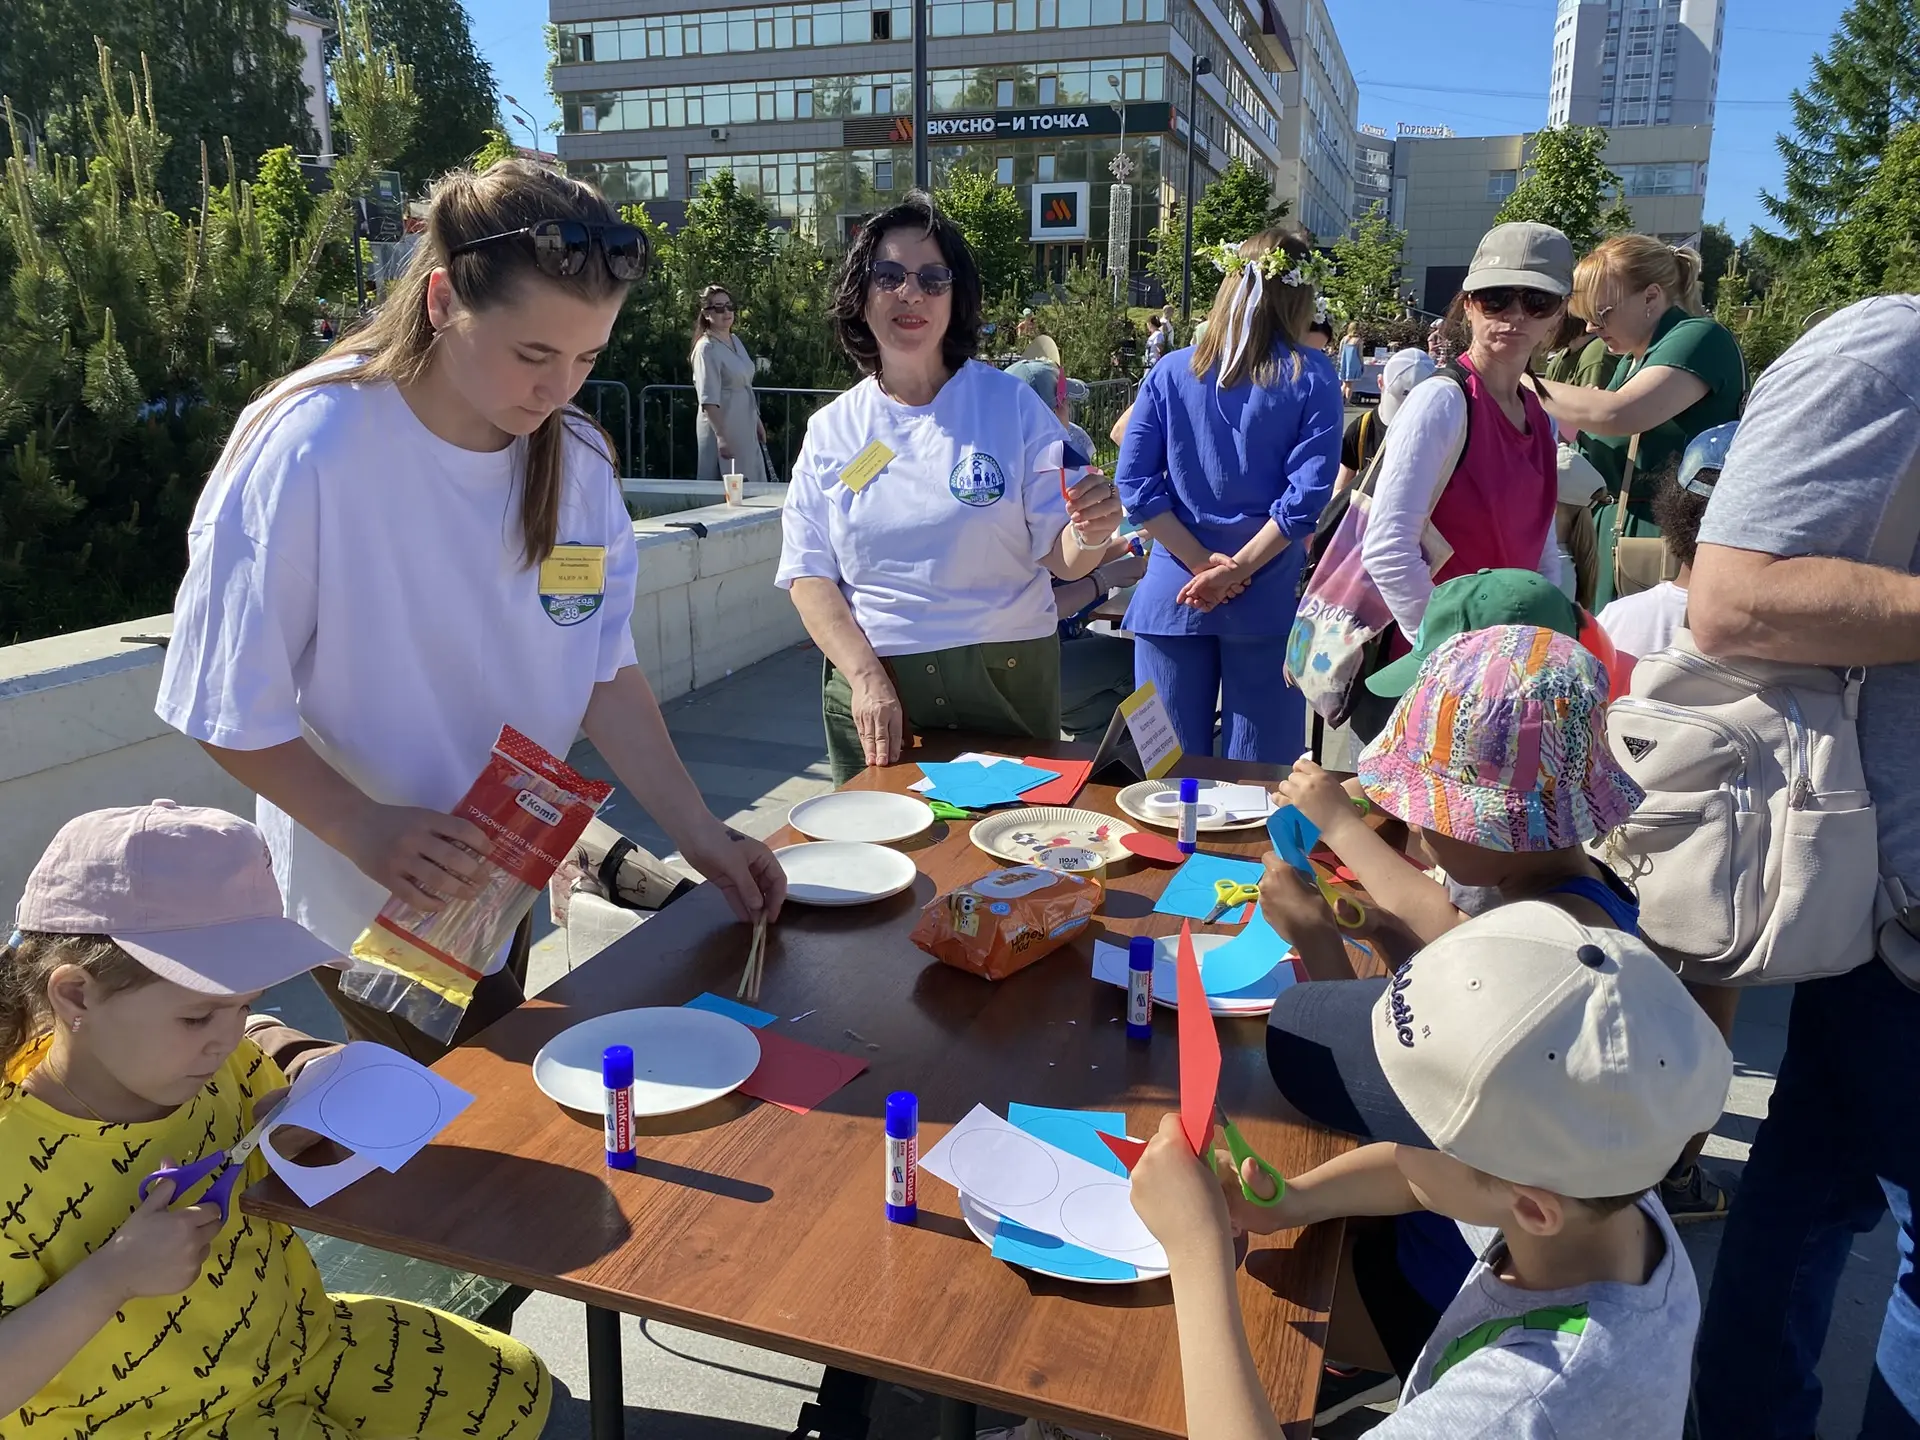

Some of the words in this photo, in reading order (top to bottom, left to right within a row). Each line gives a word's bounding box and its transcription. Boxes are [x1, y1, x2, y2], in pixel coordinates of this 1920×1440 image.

[1029, 113, 1089, 130] ТОЧКА
[467, 805, 508, 835] ТРУБОЧКИ
[506, 831, 526, 846] ДЛЯ
[525, 842, 561, 867] НАПИТКО
[527, 797, 559, 822] Komfi
[617, 1090, 628, 1150] ErichKrause
[907, 1139, 916, 1202] ErichKrause
